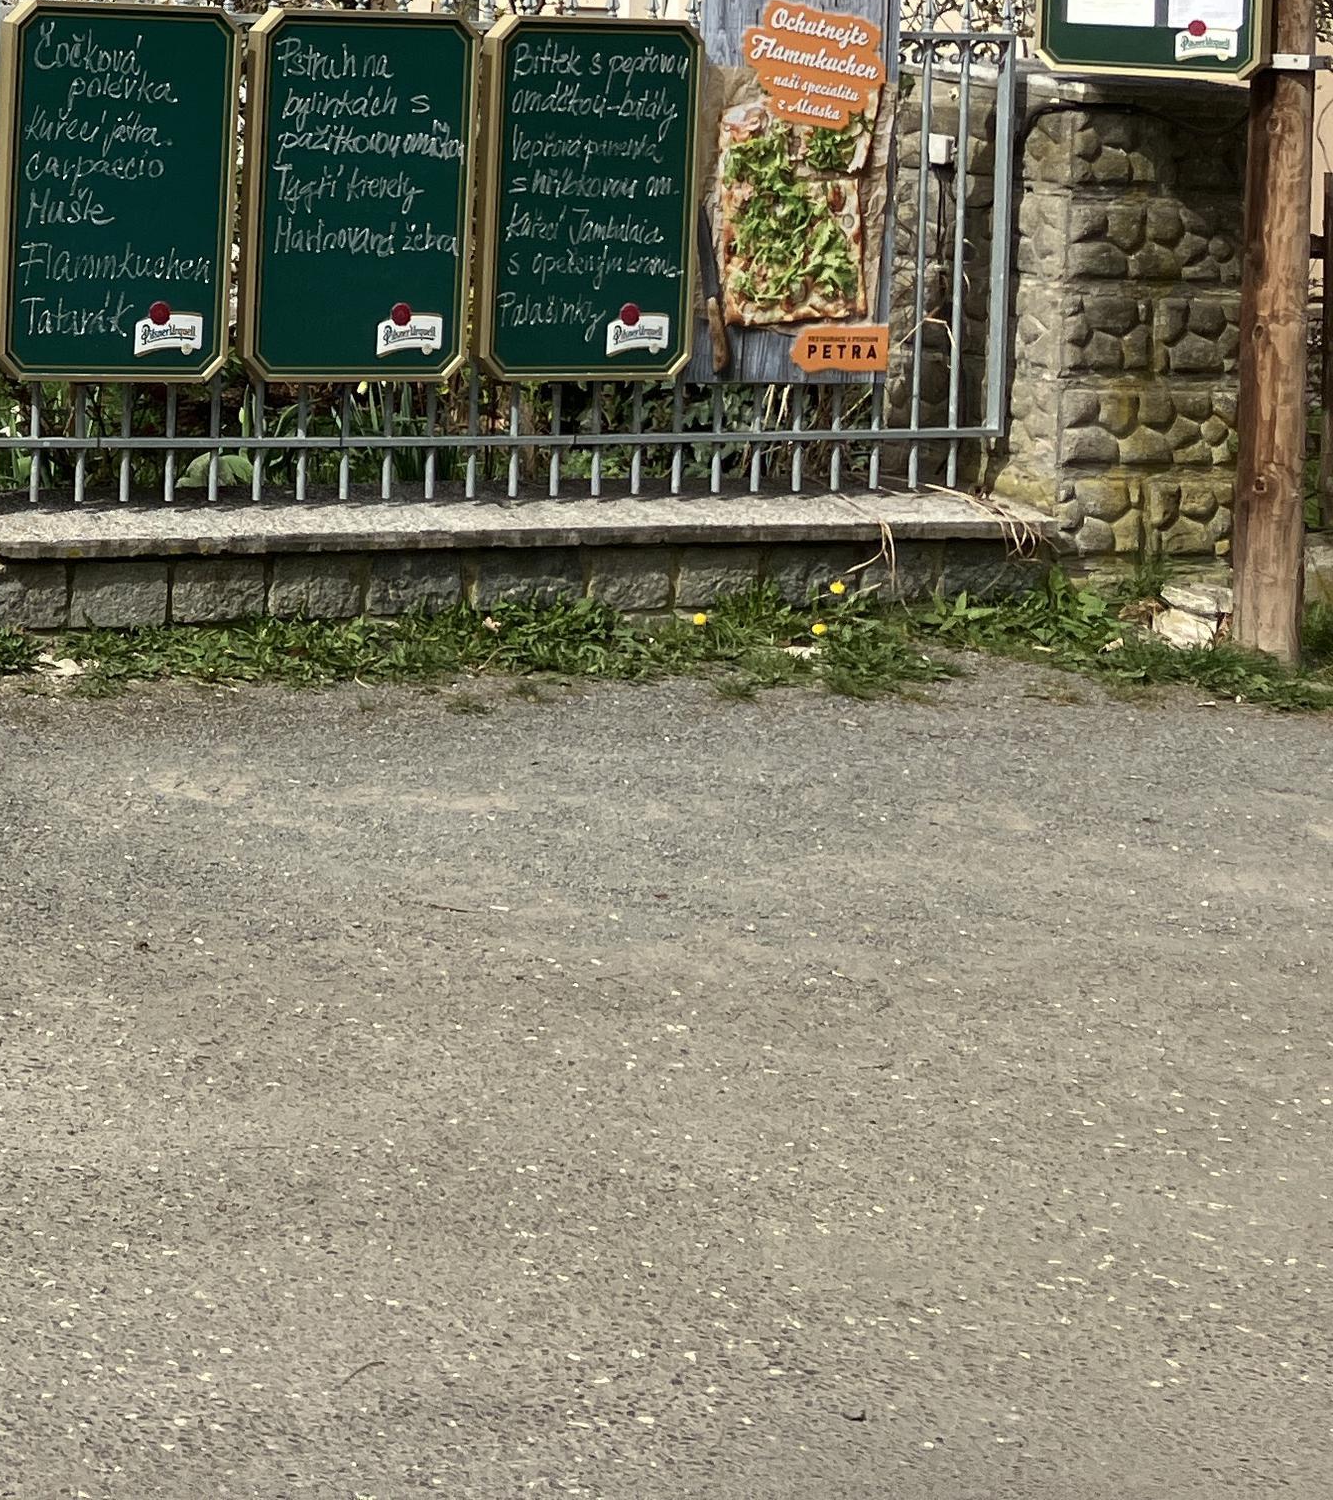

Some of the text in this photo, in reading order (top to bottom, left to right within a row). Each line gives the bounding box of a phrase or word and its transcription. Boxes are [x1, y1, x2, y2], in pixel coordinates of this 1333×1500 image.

[35, 21, 143, 76] Čočková
[771, 8, 870, 49] Ochutnejte
[275, 37, 395, 81] Pstruh na
[750, 35, 879, 79] Flammkuchen
[773, 73, 801, 89] naši
[801, 81, 860, 102] specialitu
[282, 85, 397, 133] bylinkách
[777, 98, 841, 120] z Alsaska
[25, 187, 116, 229] Mušle
[19, 242, 211, 287] Flammkuchen
[140, 323, 196, 346] Pilsner Urquell
[807, 344, 878, 360] PETRA
